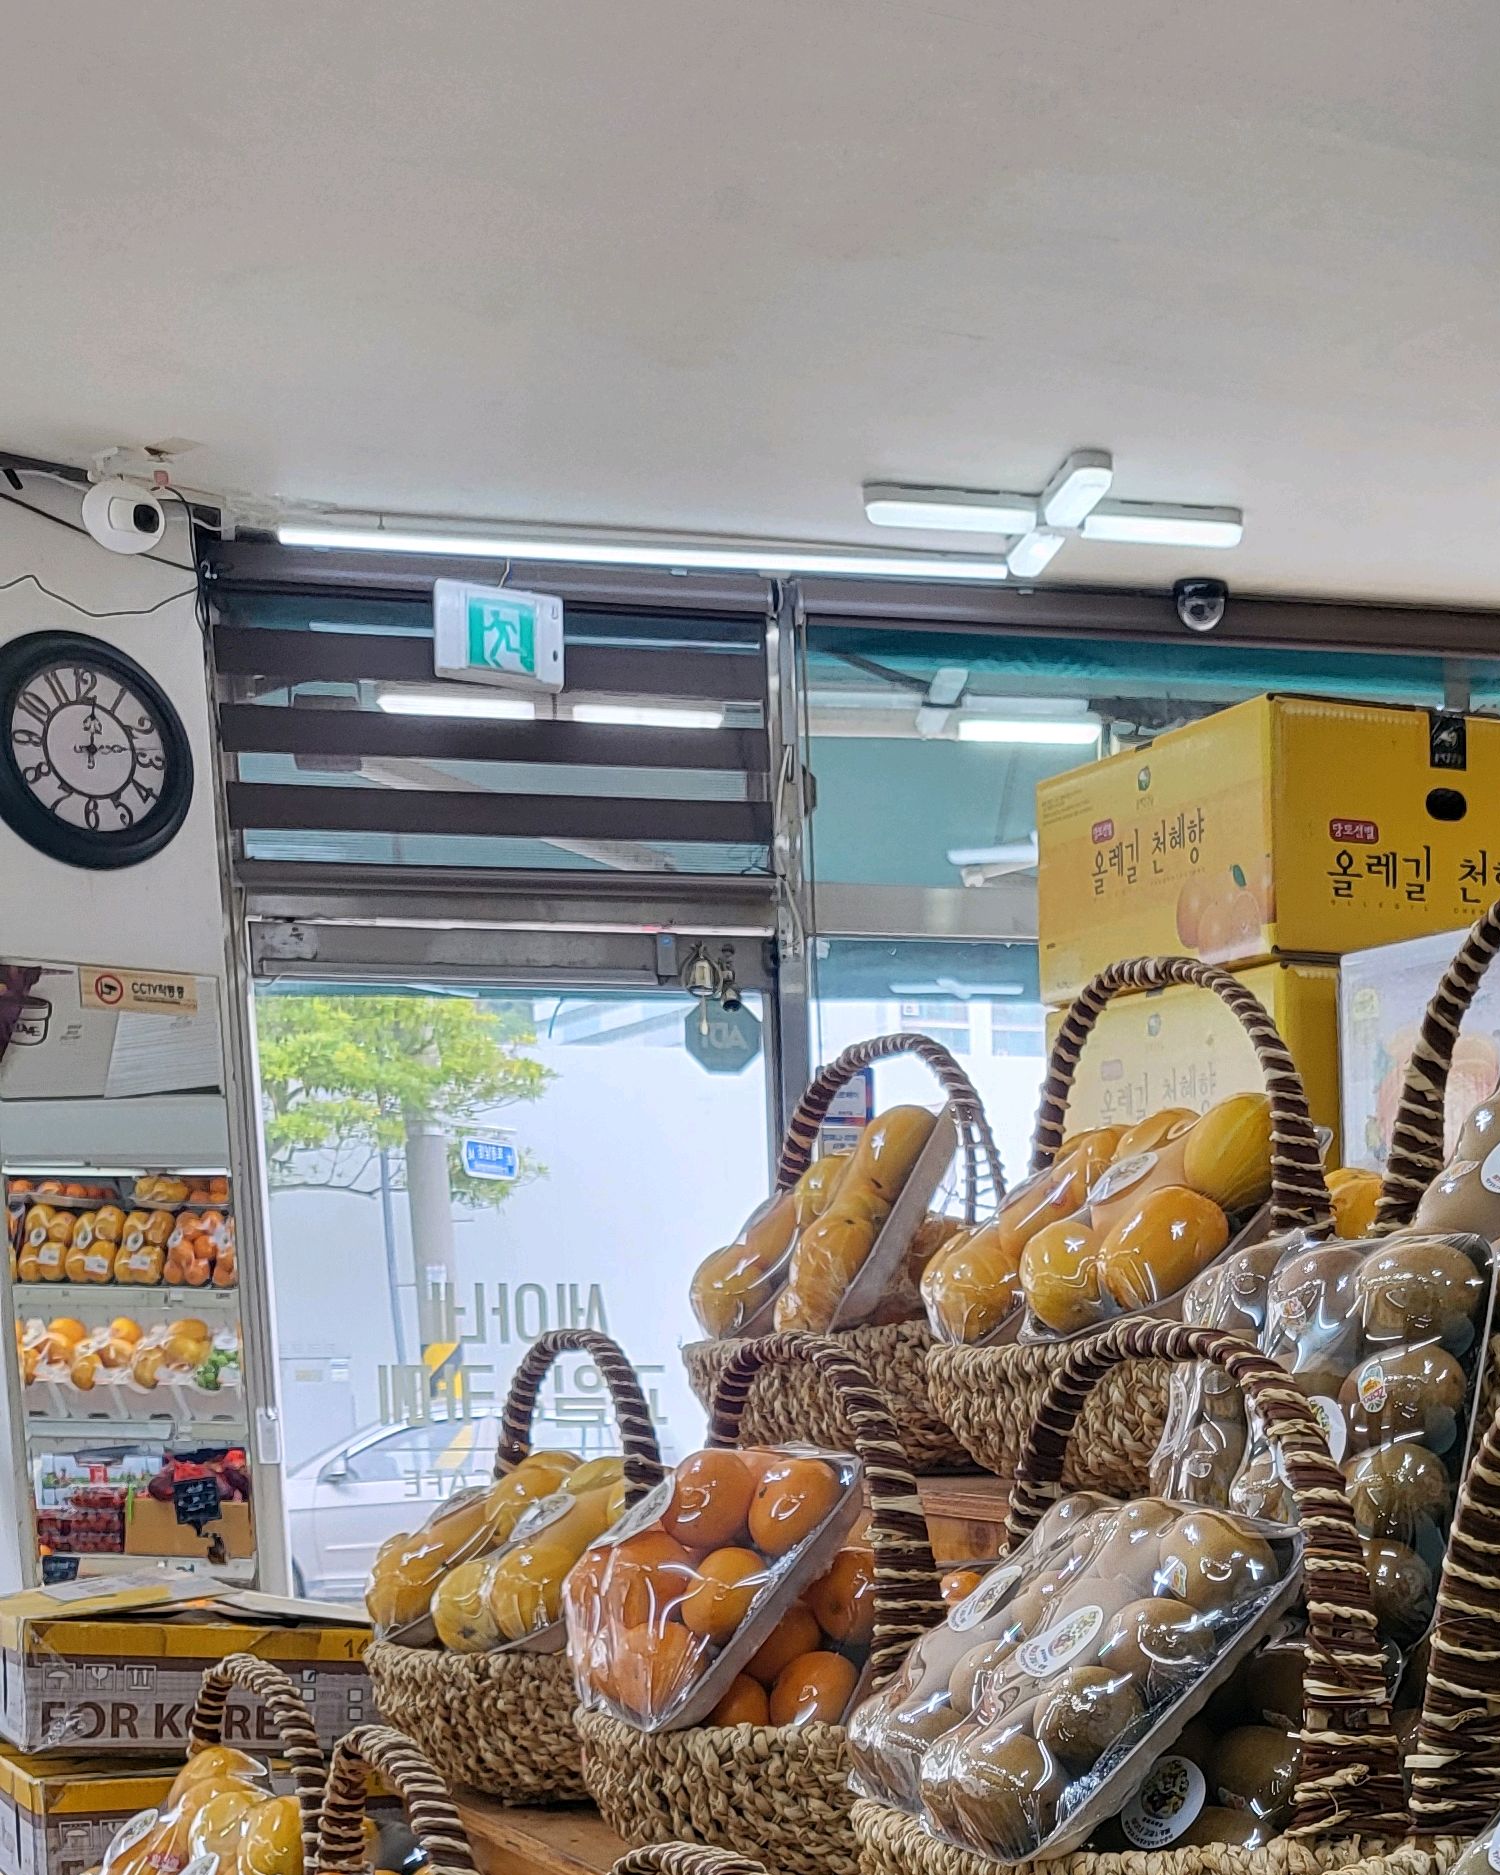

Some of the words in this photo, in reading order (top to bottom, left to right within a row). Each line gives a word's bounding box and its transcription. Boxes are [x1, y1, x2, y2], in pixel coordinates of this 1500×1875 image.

[1091, 828, 1140, 896] 올레길
[1151, 807, 1205, 875] 천혜향
[1326, 844, 1431, 902] 올레길
[41, 1701, 140, 1739] FOR
